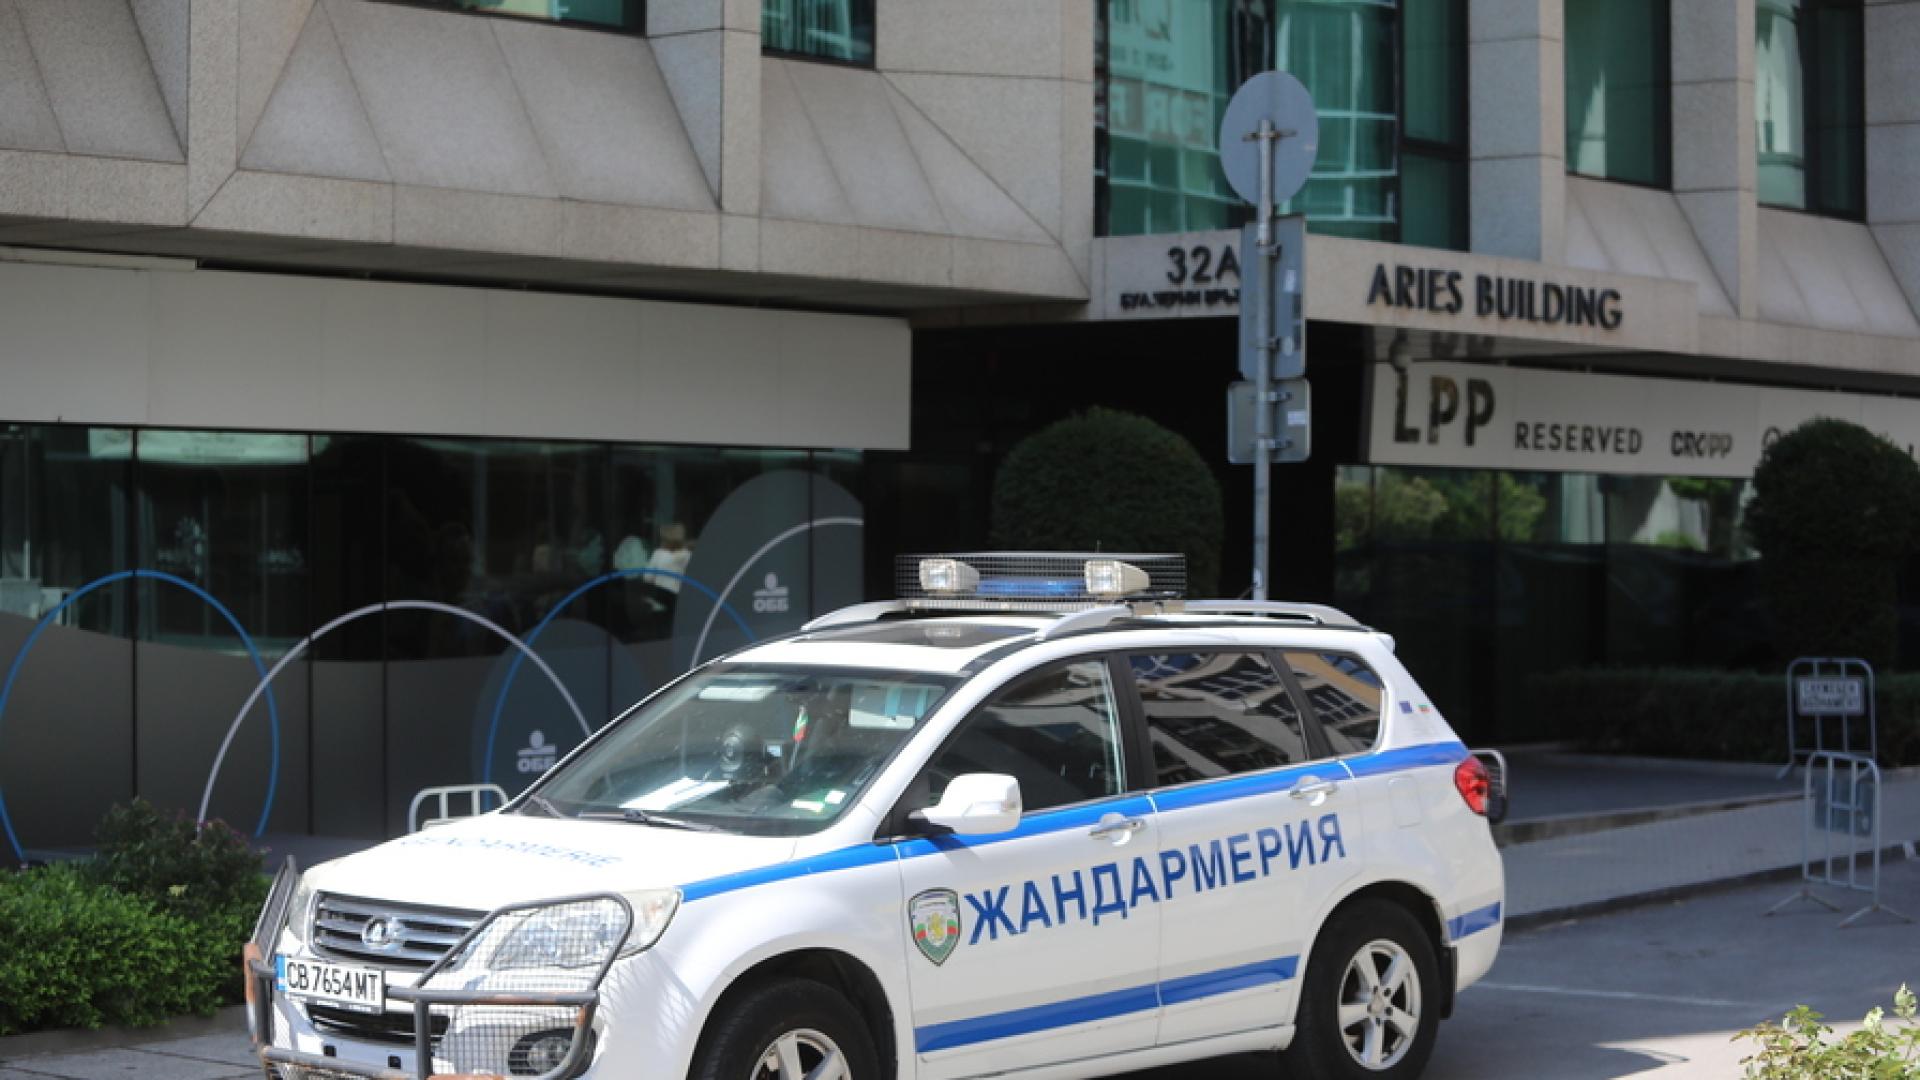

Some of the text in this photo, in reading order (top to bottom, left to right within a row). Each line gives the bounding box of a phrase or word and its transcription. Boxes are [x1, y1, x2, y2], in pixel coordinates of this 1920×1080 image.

[1367, 263, 1623, 329] ARIES BUILDING
[1394, 366, 1496, 446] LPP
[1514, 421, 1643, 454] RESERVED
[963, 813, 1346, 945] ЖАНДАРМЕРИЯ
